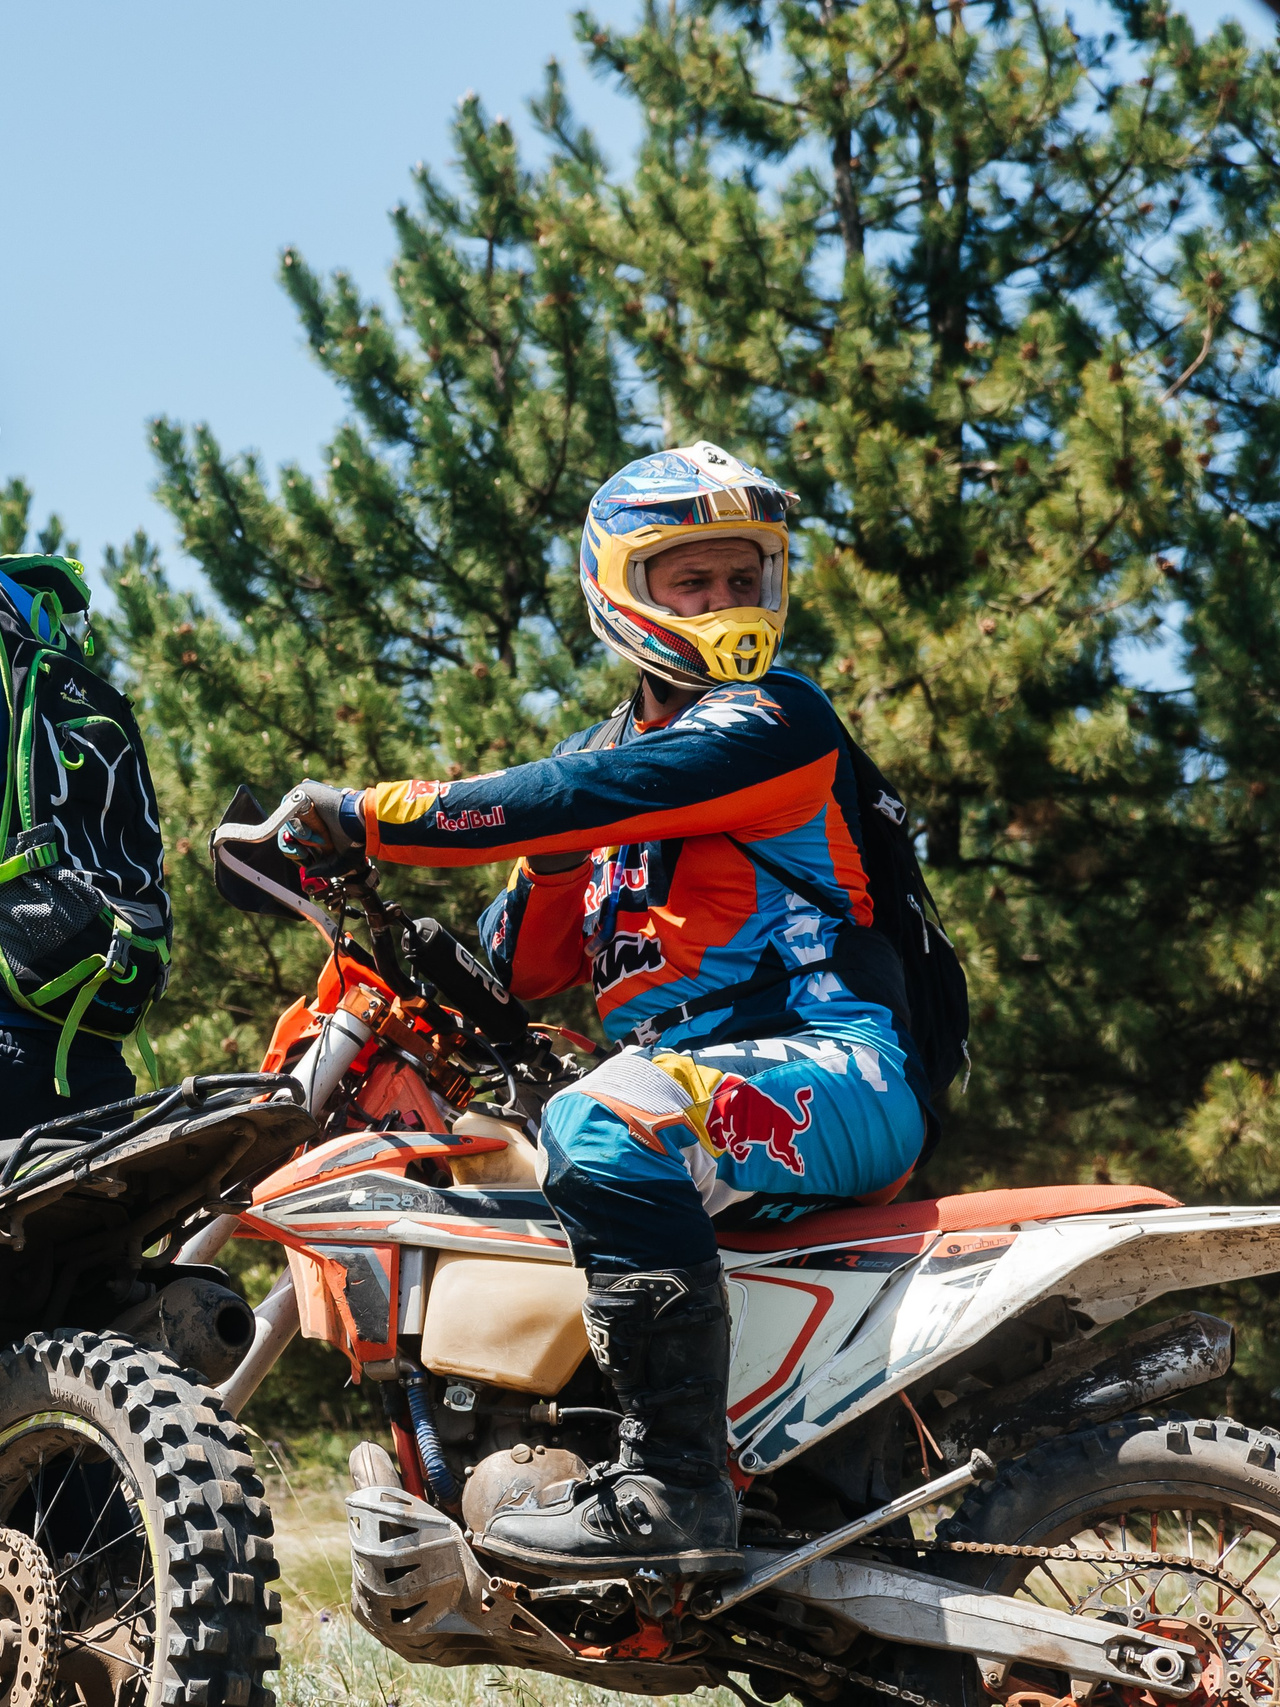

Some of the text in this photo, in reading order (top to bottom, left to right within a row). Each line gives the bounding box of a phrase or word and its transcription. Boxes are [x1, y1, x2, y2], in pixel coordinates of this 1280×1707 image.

[436, 805, 506, 831] Red Bull
[592, 930, 666, 1001] KTM
[963, 1237, 1008, 1251] mobius
